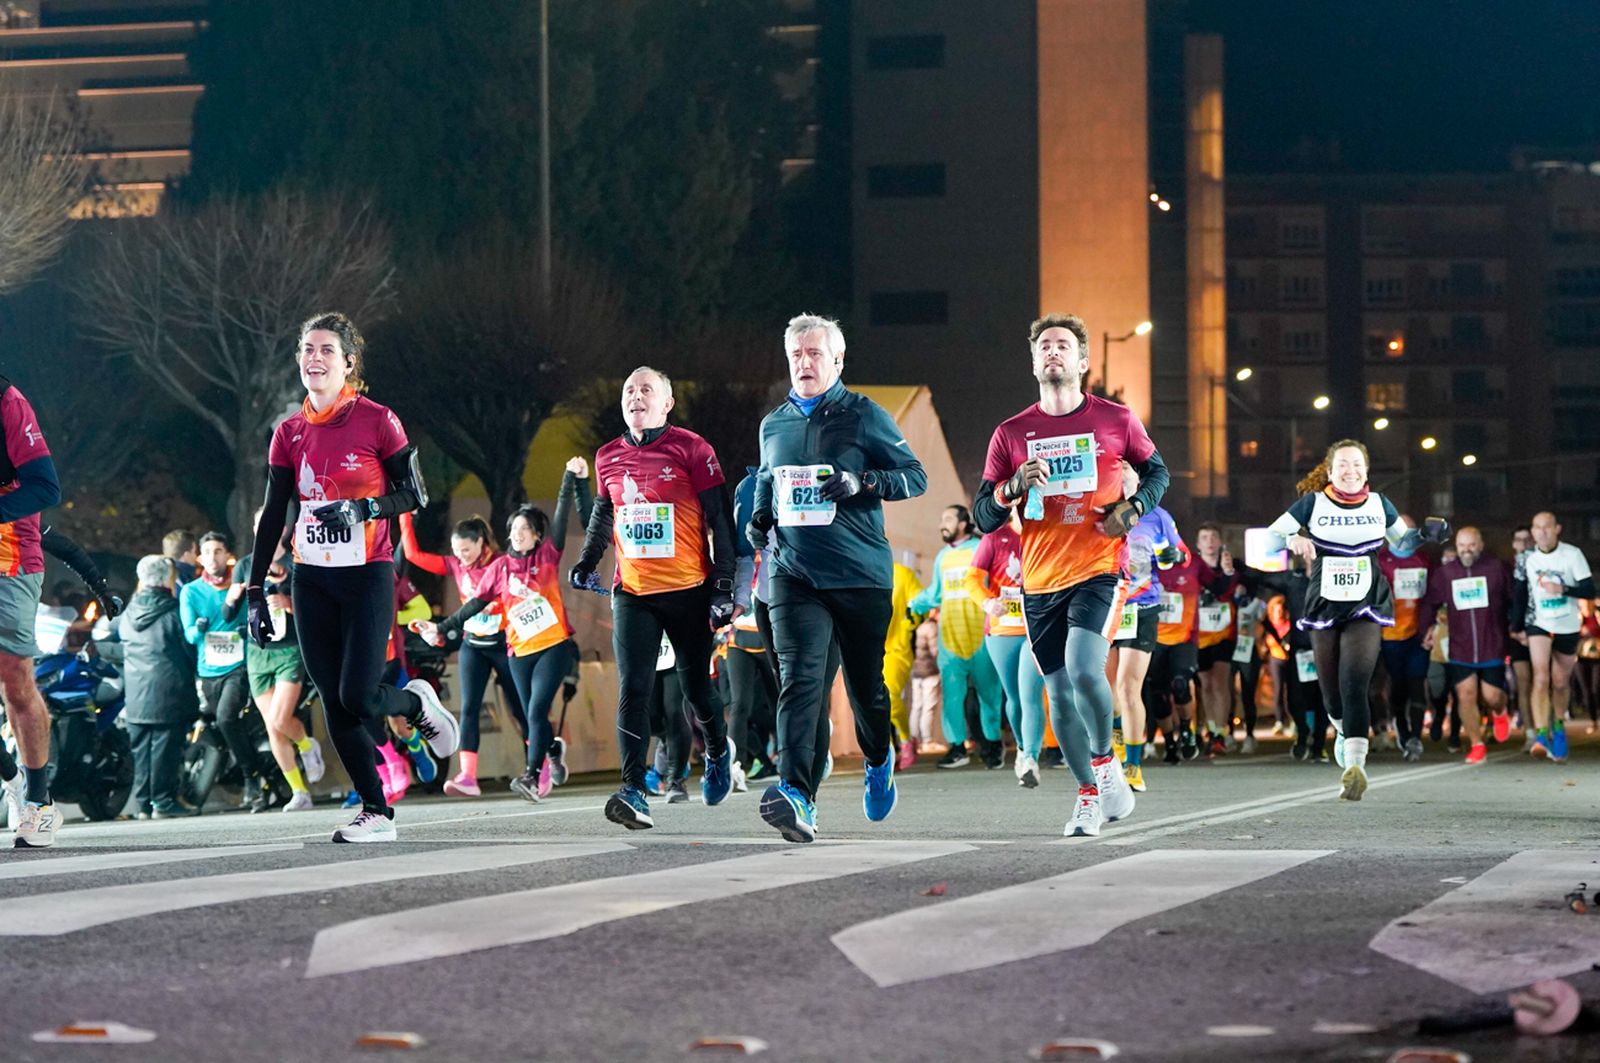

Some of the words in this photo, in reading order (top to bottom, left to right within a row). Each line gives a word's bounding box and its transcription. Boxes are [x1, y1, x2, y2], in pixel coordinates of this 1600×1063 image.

[1042, 442, 1061, 450] NOCHE
[1333, 573, 1361, 586] 1857
[520, 606, 544, 625] 5527
[213, 644, 235, 653] 1252
